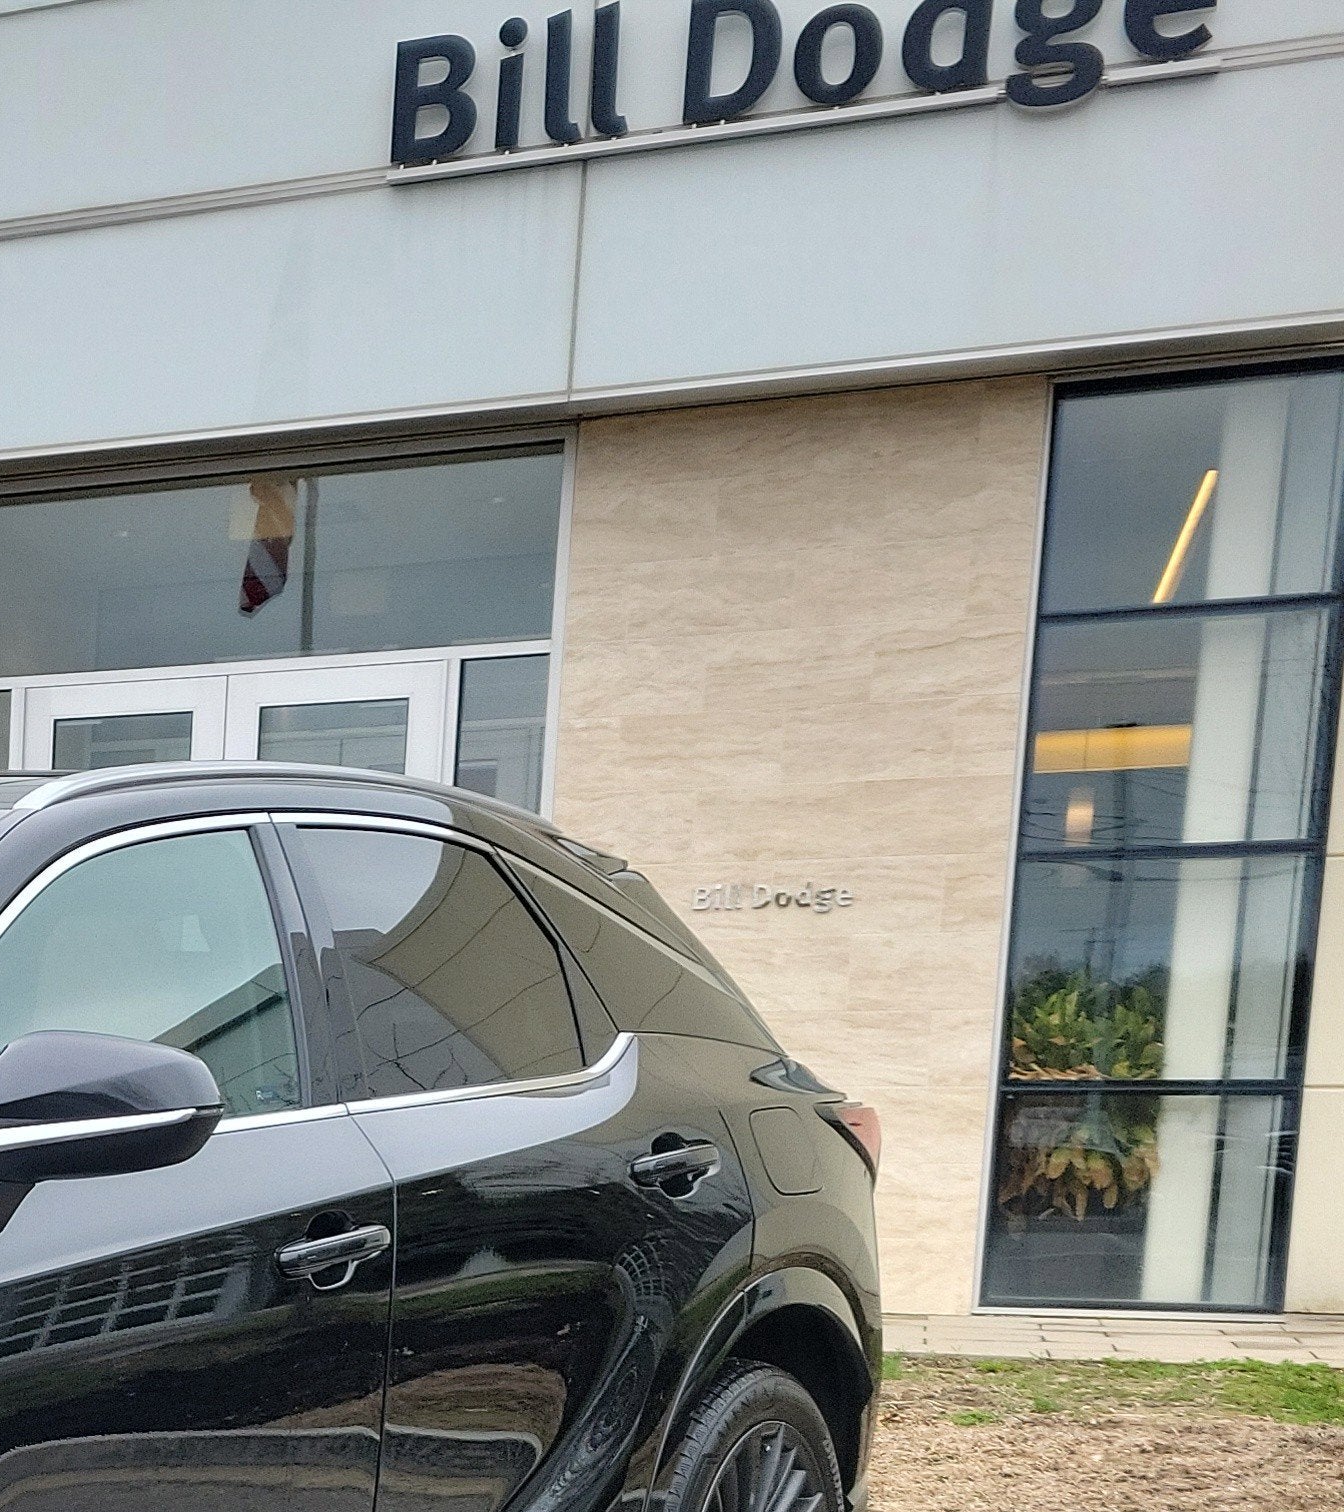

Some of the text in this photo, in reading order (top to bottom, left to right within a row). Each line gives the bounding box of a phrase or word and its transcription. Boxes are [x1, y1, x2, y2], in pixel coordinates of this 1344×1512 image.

[391, 0, 1216, 166] Bill Dodge
[692, 881, 855, 913] Bill Dodge
